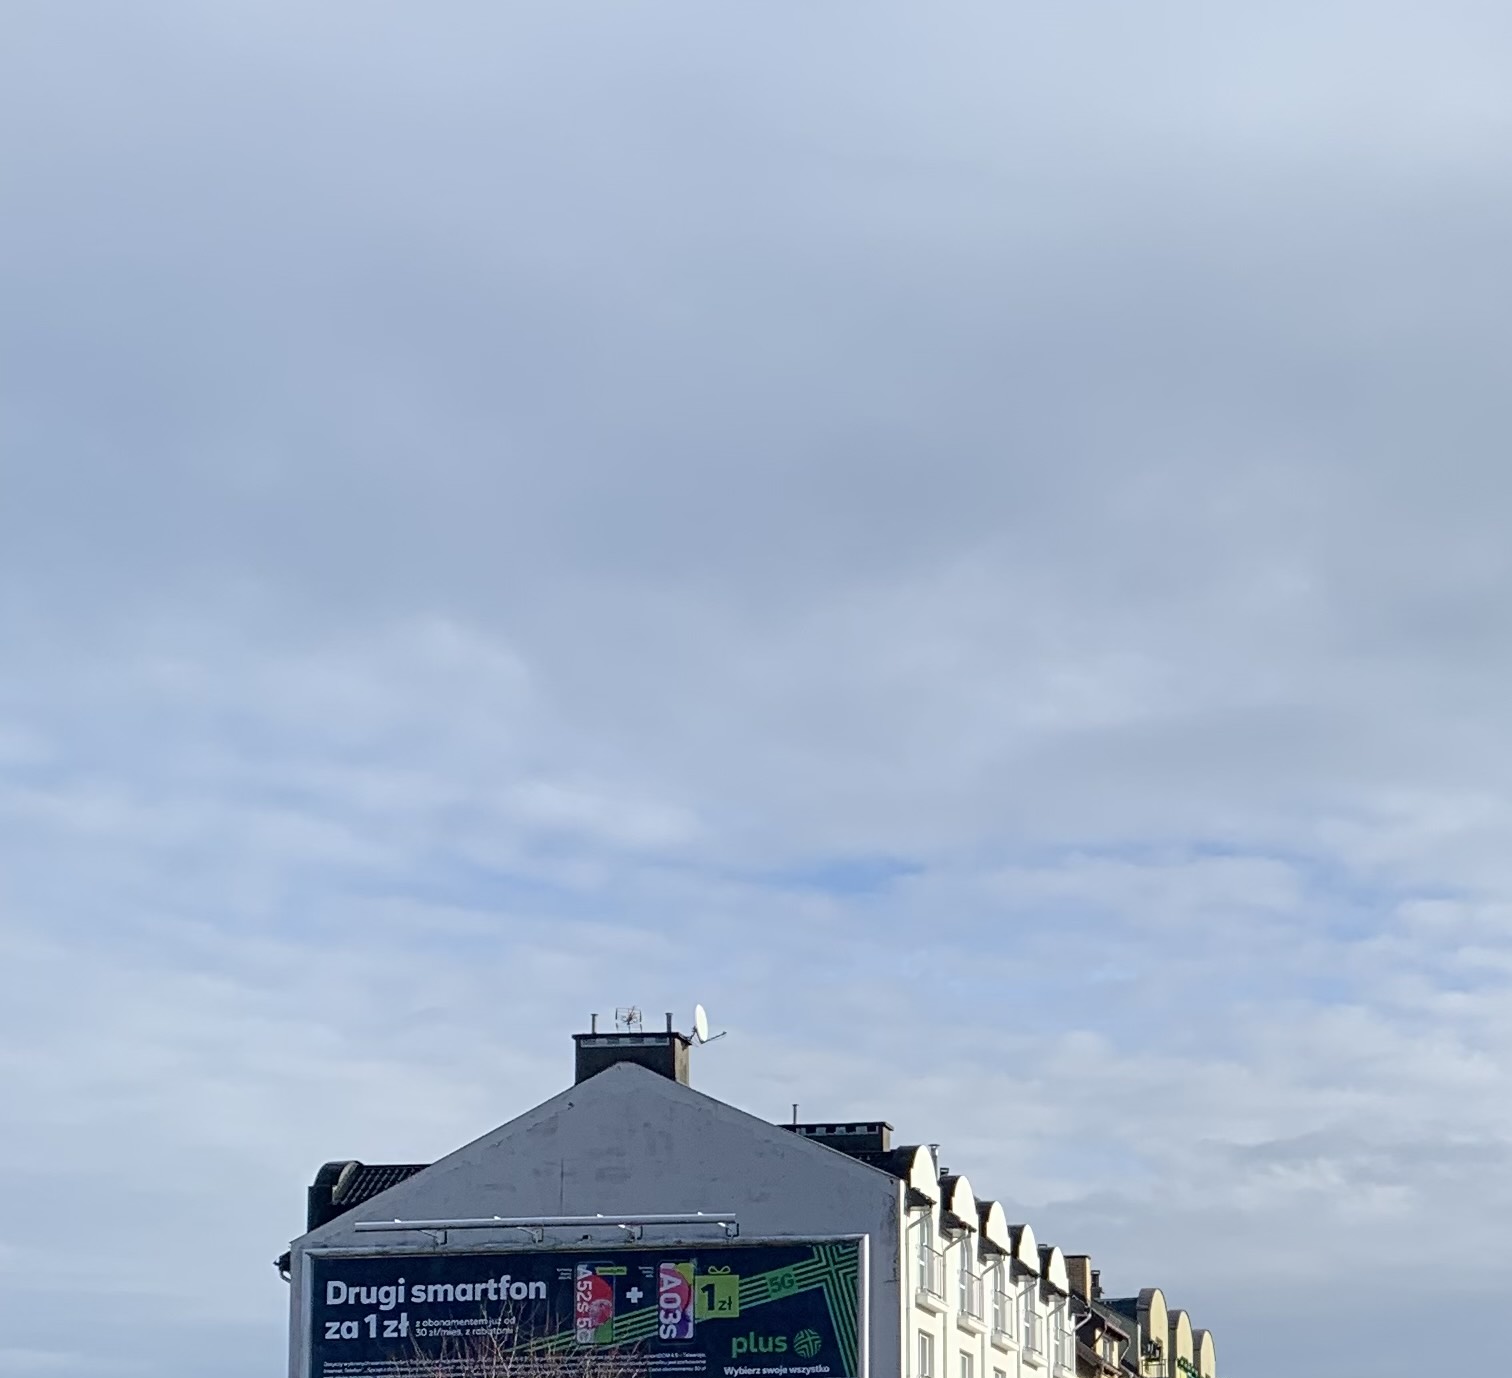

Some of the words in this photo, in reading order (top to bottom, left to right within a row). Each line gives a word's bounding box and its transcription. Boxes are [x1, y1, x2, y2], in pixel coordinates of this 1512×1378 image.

[326, 1278, 405, 1311] Drugi
[411, 1275, 546, 1302] smartfon
[769, 1273, 795, 1293] 5G
[701, 1283, 715, 1311] 1
[718, 1296, 732, 1311] zł
[324, 1320, 359, 1340] za
[363, 1314, 377, 1338] 1
[383, 1312, 409, 1338] zł
[415, 1328, 427, 1337] 30
[422, 1318, 488, 1327] abonamentem
[503, 1316, 516, 1325] od
[731, 1331, 788, 1358] plus
[723, 1366, 761, 1378] Wybierz
[789, 1364, 831, 1376] wszystko
